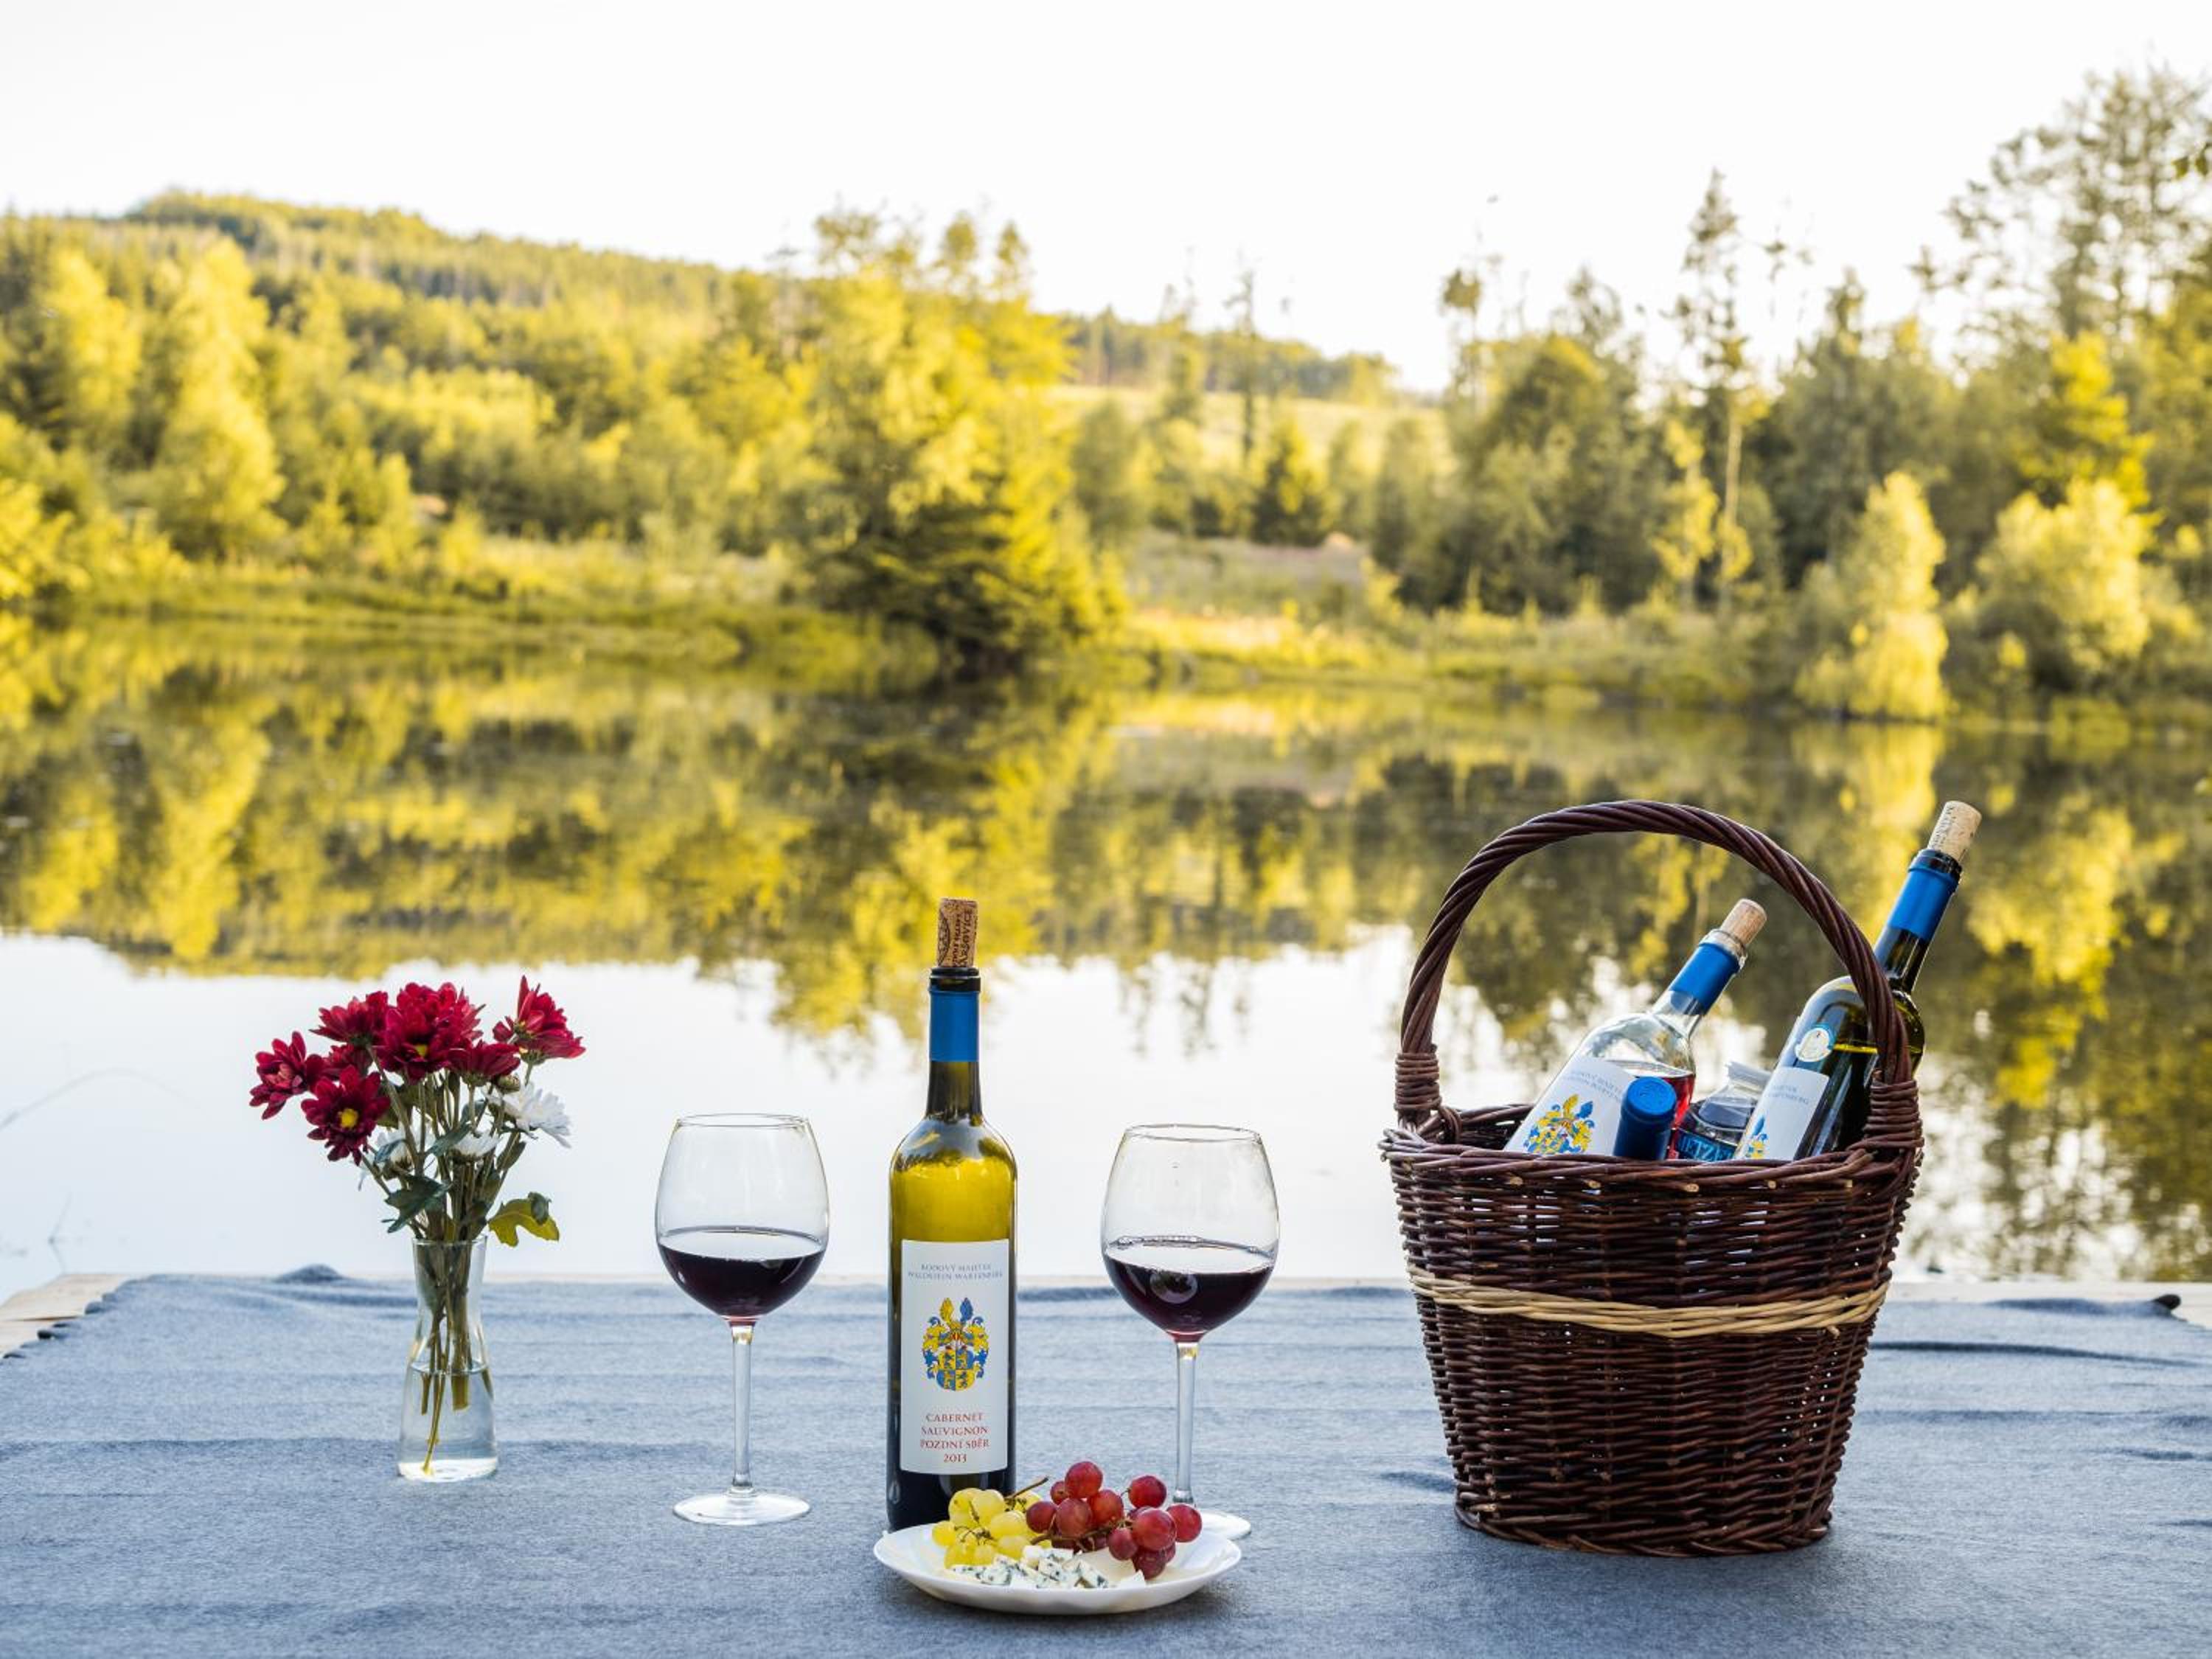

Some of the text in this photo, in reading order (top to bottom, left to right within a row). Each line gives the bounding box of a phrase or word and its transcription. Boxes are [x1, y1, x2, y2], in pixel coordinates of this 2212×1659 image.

[925, 1413, 984, 1422] CABERNET
[921, 1426, 989, 1436] SAUVIGNON
[944, 1453, 967, 1463] 2013
